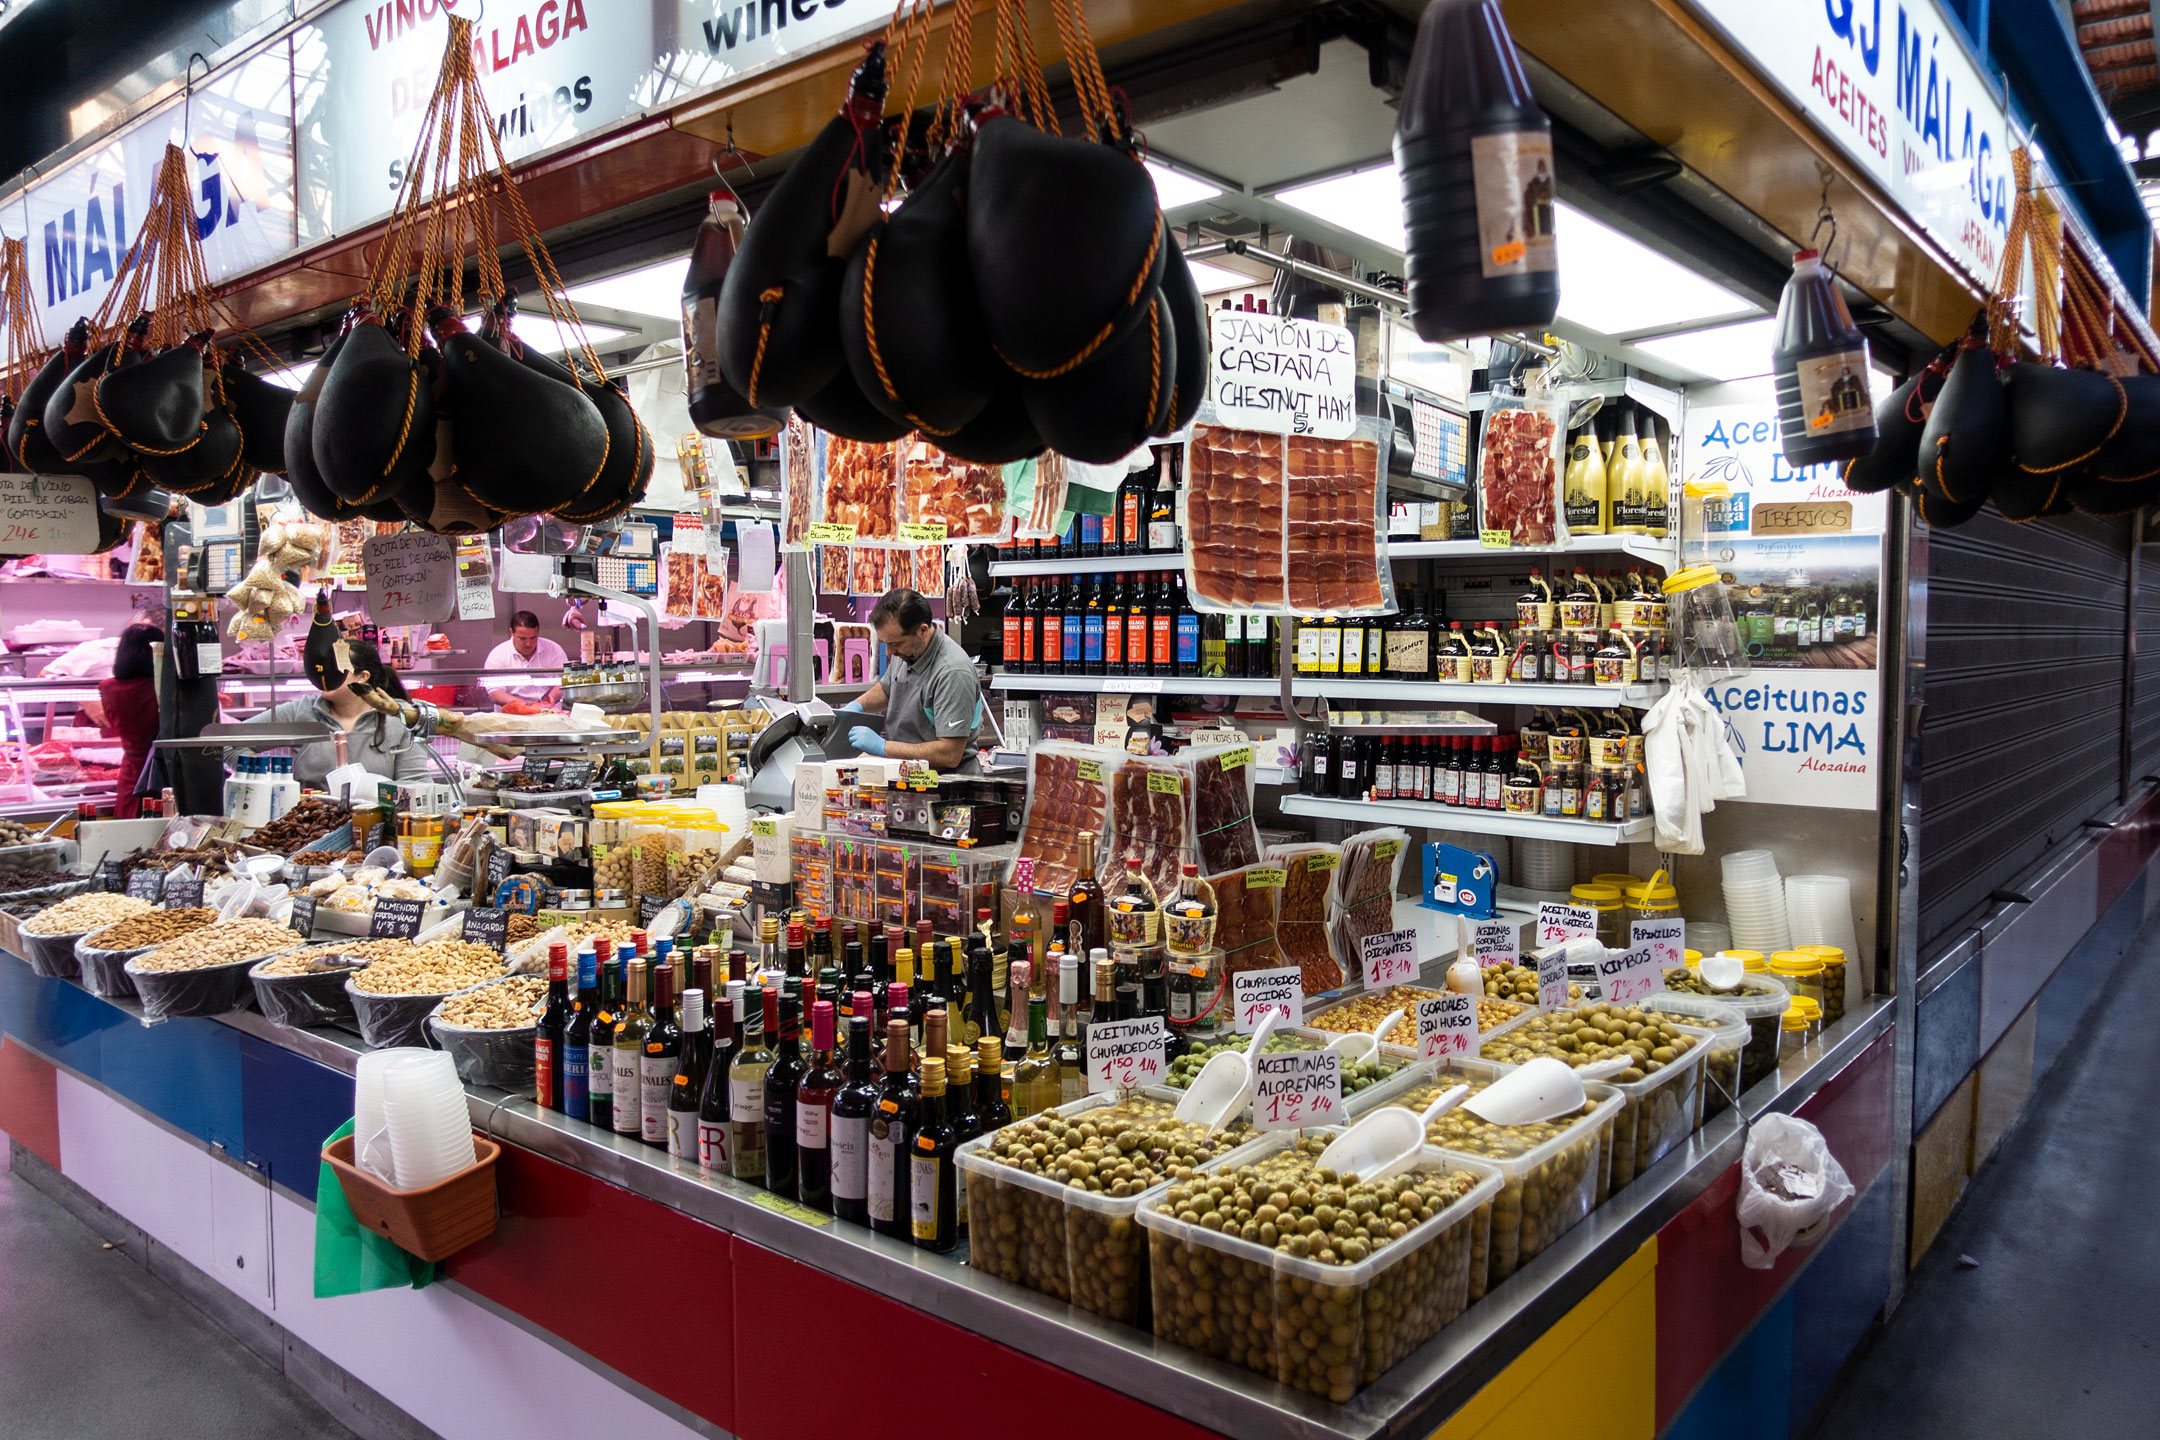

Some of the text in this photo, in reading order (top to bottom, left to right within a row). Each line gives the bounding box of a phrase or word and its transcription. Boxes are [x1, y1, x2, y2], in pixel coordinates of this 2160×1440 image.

[472, 0, 588, 76] ÁLAGA
[702, 0, 848, 56] wine
[1811, 44, 1887, 159] ACEITES
[1896, 2, 2007, 241] MÁLAGA
[1219, 319, 1351, 355] JAMÓN DE
[1219, 346, 1332, 386] CASTAÑA
[20, 481, 34, 490] DE
[41, 480, 72, 491] VINO
[2, 494, 89, 505] PIEL DE CABRA
[1566, 506, 1596, 515] lorestel
[2, 525, 40, 542] 24€
[372, 534, 440, 557] BOTA DE VINO
[368, 563, 381, 576] DE
[383, 558, 407, 570] PIEL
[409, 553, 420, 564] DE
[423, 551, 451, 563] CABRA
[381, 591, 413, 611] 27€
[1704, 684, 1868, 716] Aceitunas
[1196, 734, 1243, 744] HAY HOJAS DE
[1761, 721, 1867, 756] LIMA
[1797, 756, 1867, 774] Alozaina
[798, 792, 819, 800] Maldon
[756, 848, 776, 856] Maldon
[377, 901, 420, 912] ALMENDRA
[1541, 905, 1592, 920] ACEITUNAS
[465, 920, 505, 932] ANACARDO
[1476, 926, 1511, 936] ACEITUNAS
[1540, 915, 1595, 930] A LA GRIEGA
[1363, 928, 1417, 949] ACEITUNAS
[1632, 927, 1682, 941] PEPINILLOS
[1364, 941, 1413, 962] PICANTES
[1540, 952, 1567, 972] ACEITUNAS
[1600, 948, 1651, 977] KIMBOS
[1235, 974, 1301, 989] CHUPADEDOS
[1540, 966, 1565, 988] GORDALES
[1240, 987, 1293, 1003] COCIDAS
[1420, 998, 1469, 1017] GORDALES
[1091, 1021, 1160, 1042] ACEITUNAS
[1420, 1014, 1472, 1036] SIN HUESO
[1089, 1037, 1163, 1060] CHUPADEDOS
[1138, 1056, 1157, 1076] 1/4
[1257, 1054, 1336, 1075] ACEITUNAS
[1257, 1073, 1336, 1097] ALOREÑAS
[1310, 1095, 1333, 1113] 1/4
